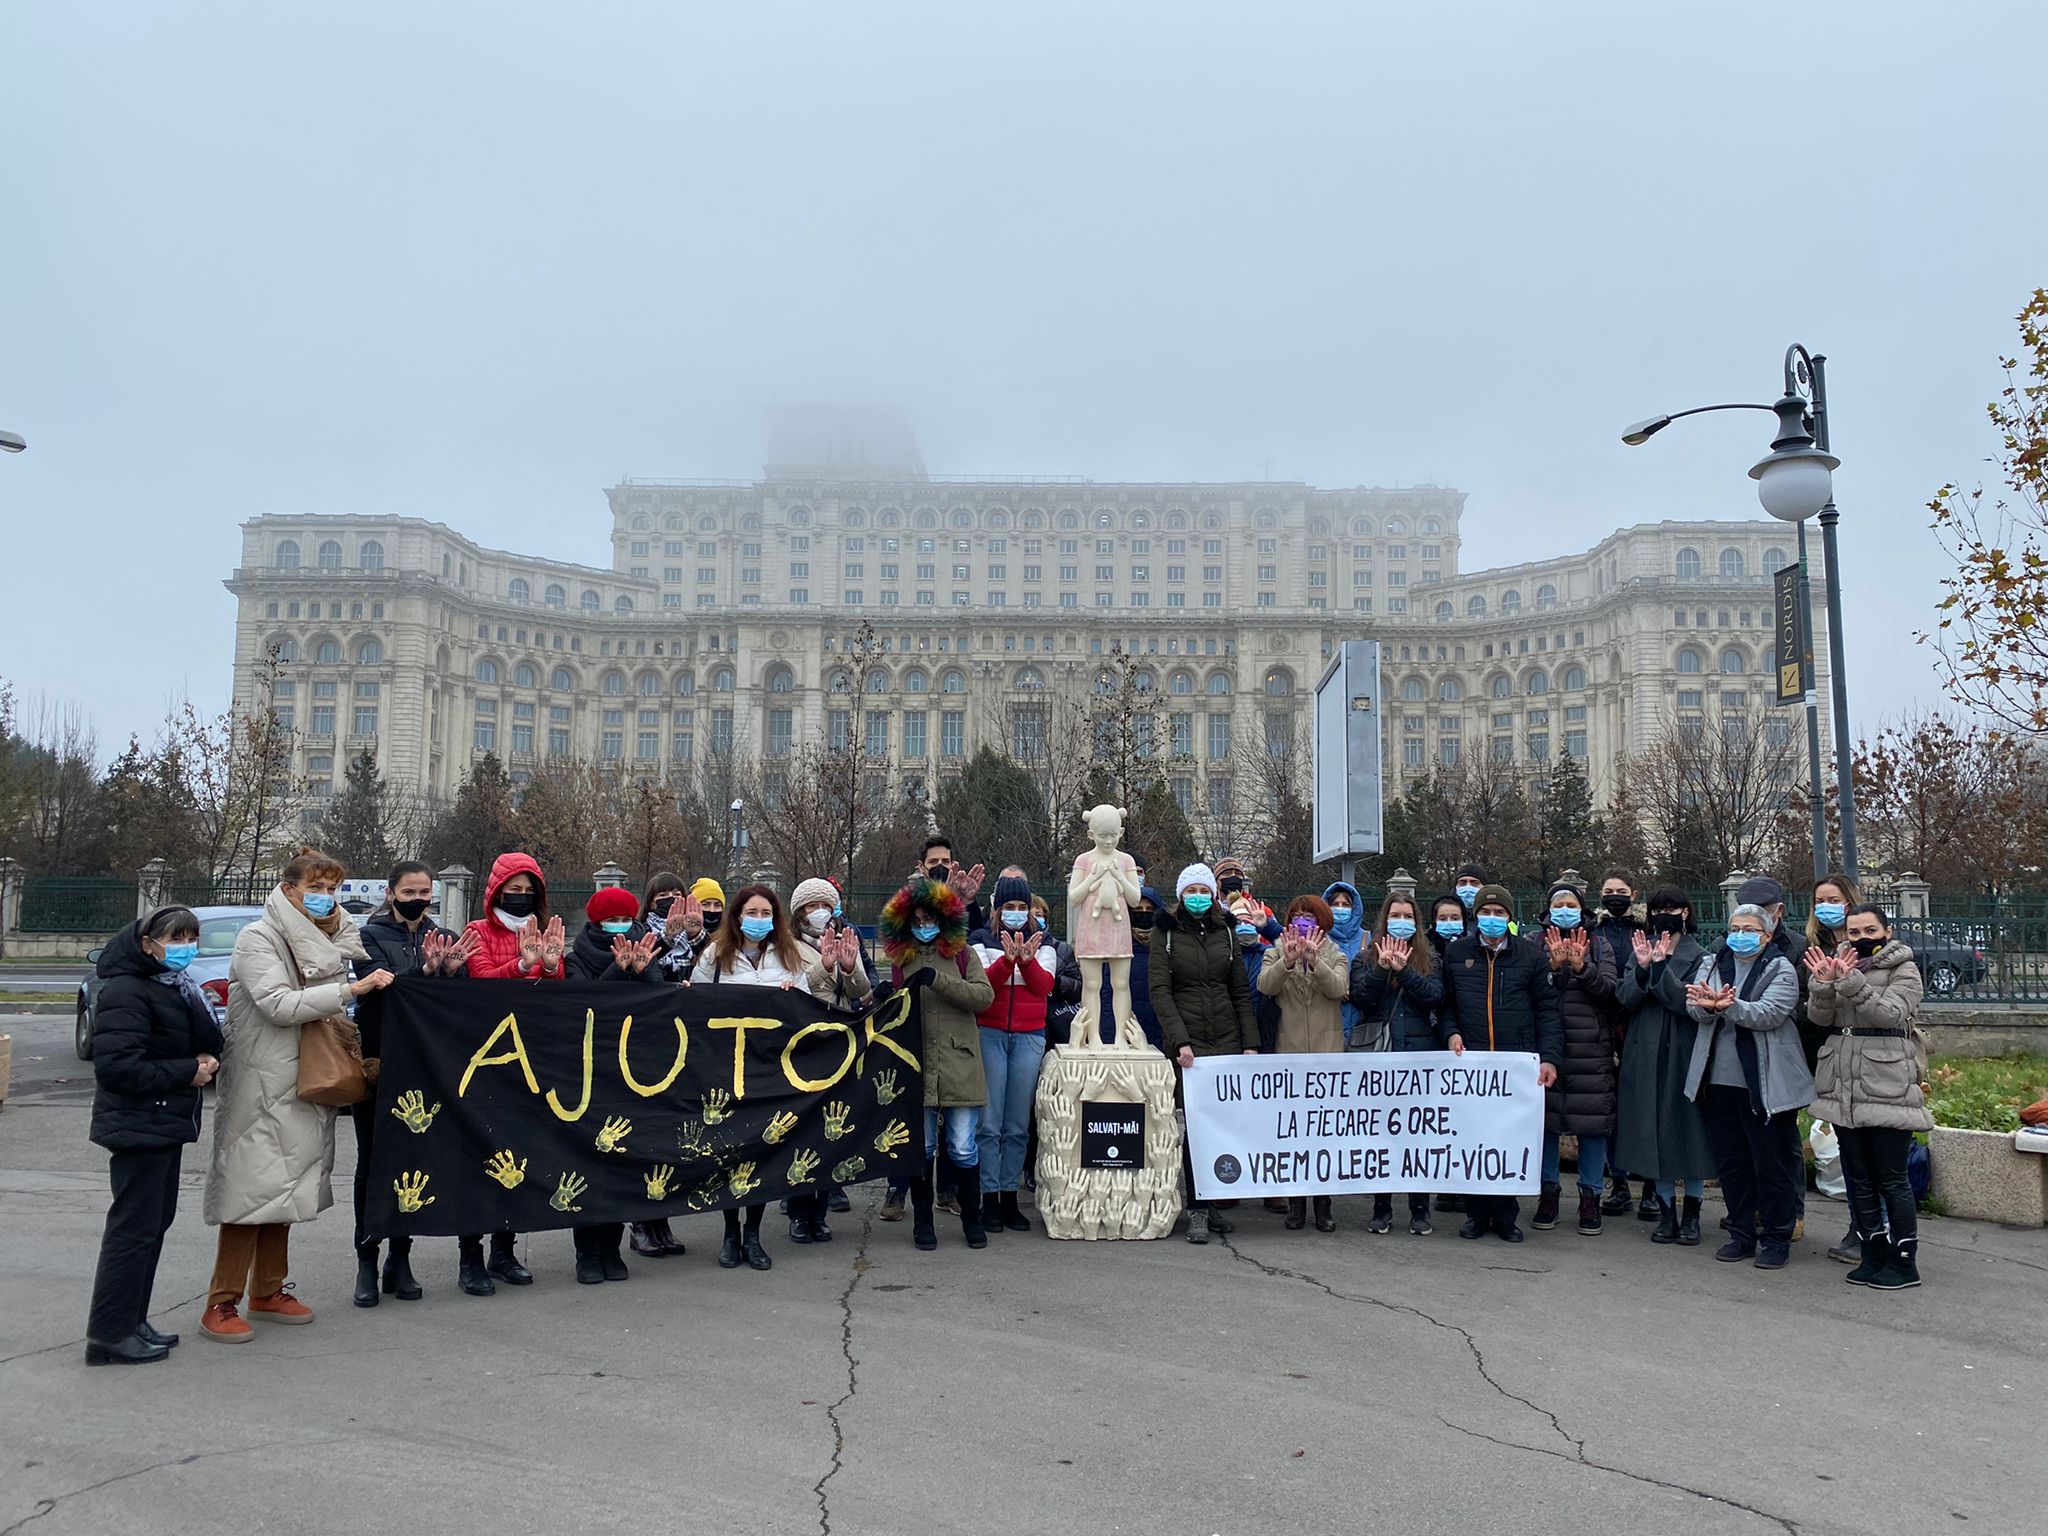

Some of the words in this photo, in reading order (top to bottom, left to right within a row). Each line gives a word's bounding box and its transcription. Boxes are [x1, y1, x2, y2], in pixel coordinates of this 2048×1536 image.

[1783, 576, 1794, 660] NORDIS
[458, 987, 922, 1122] AJUTOR
[1216, 1074, 1242, 1101] UN
[1251, 1069, 1300, 1100] COPIL
[1305, 1071, 1352, 1099] ESTE
[1357, 1068, 1434, 1097] ABUZAT
[1440, 1068, 1513, 1097] SEXUAL
[1277, 1110, 1298, 1139] LA
[1306, 1105, 1382, 1137] FIECARE
[1387, 1108, 1401, 1136] 6
[1408, 1106, 1458, 1137] ORE.
[1248, 1150, 1310, 1184] VREM
[1316, 1149, 1331, 1182] O
[1338, 1148, 1390, 1181] LEGE
